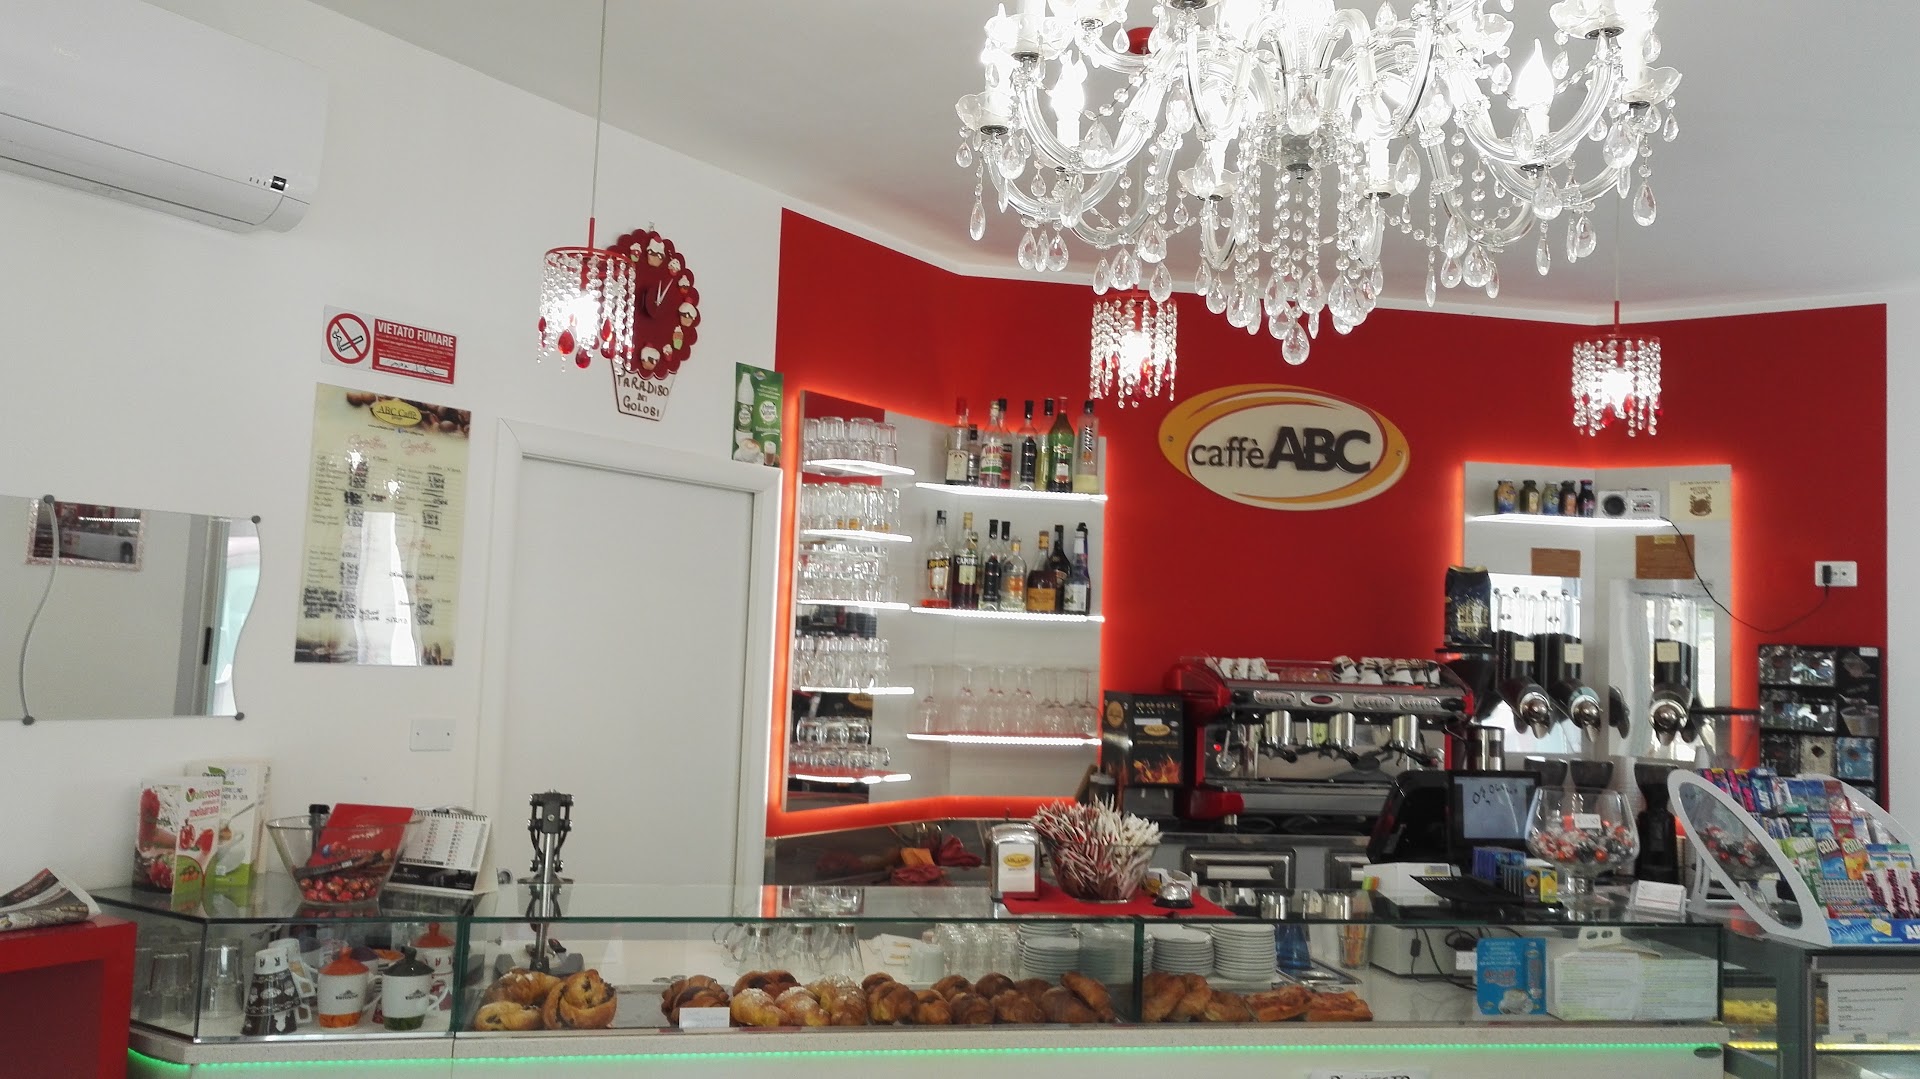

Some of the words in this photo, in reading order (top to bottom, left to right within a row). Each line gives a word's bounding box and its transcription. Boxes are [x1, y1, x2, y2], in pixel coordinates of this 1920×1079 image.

[377, 320, 415, 340] VIETATO
[417, 329, 455, 349] FUMARE
[617, 367, 670, 397] PARADISO
[623, 395, 660, 418] GOLOSI
[1191, 436, 1265, 469] caffè
[1265, 425, 1372, 475] ABC
